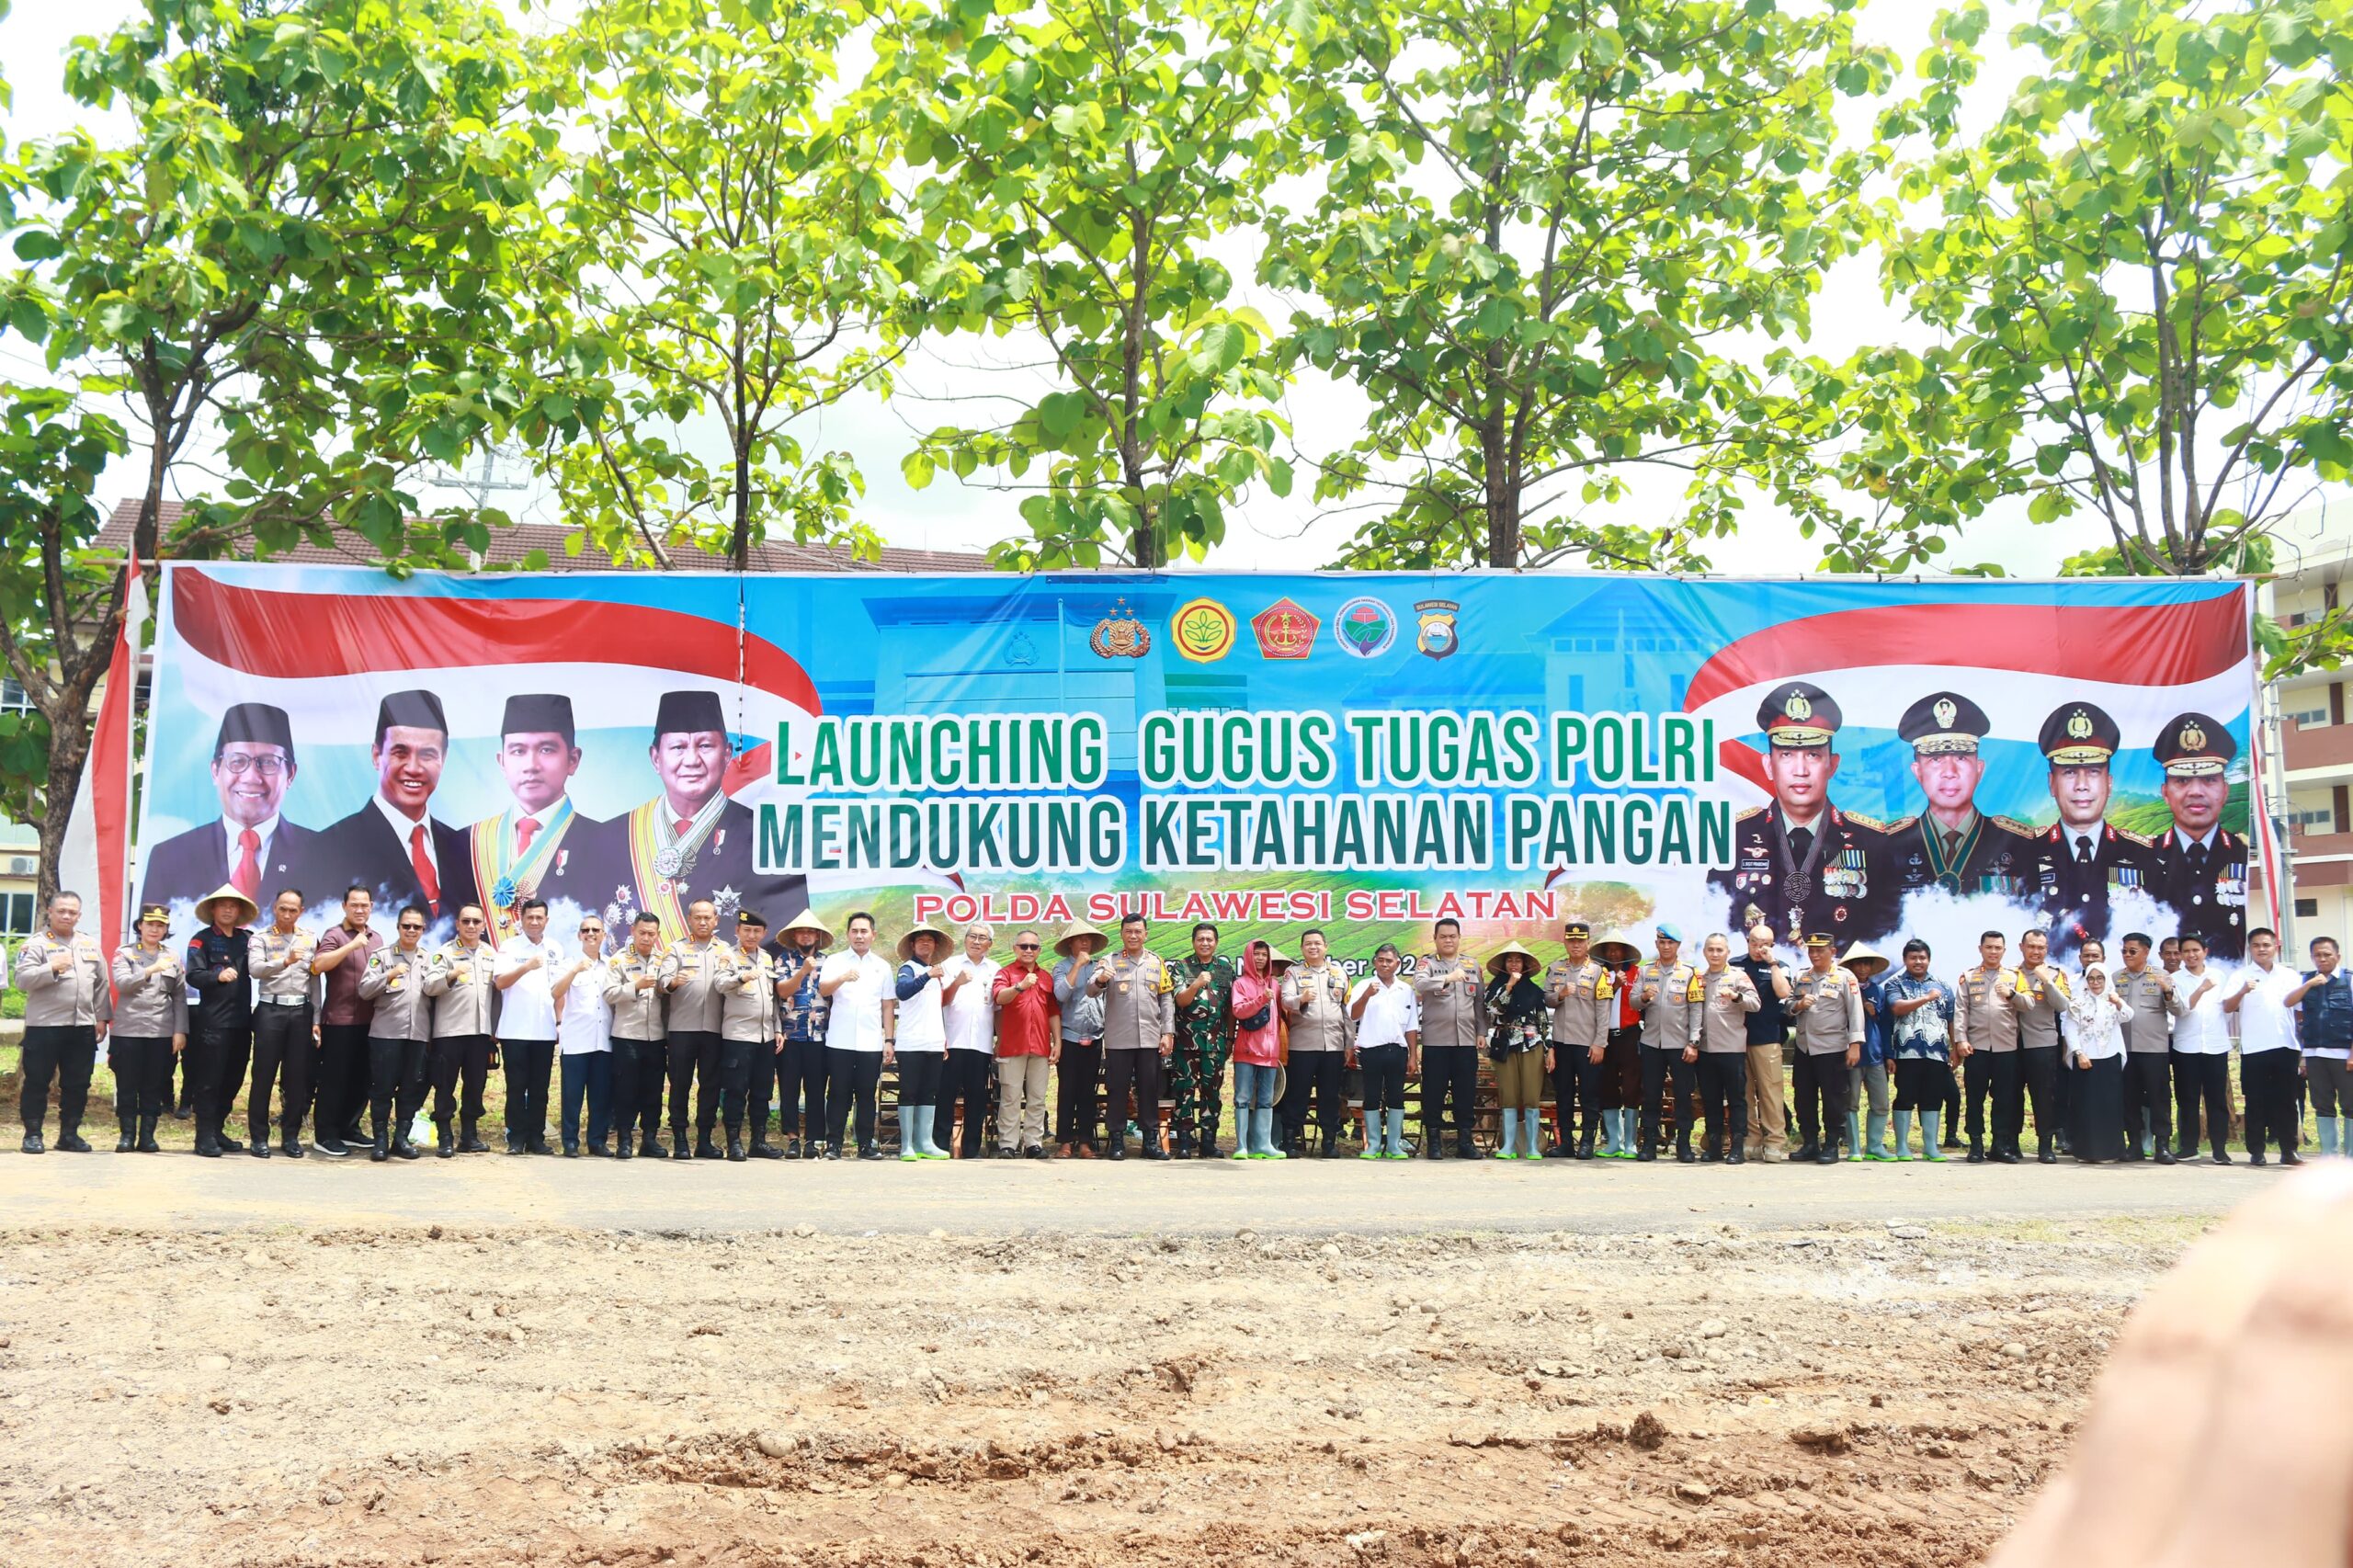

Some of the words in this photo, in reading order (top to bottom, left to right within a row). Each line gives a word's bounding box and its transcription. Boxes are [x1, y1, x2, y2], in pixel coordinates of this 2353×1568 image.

[777, 718, 1102, 787] LAUNCHING
[1144, 716, 1330, 783] GUGUS
[1351, 716, 1534, 782] TUGAS
[1557, 717, 1714, 782] POLRI
[758, 801, 1120, 869] MENDUKUNG
[1146, 800, 1486, 865] KETAHANAN
[1512, 800, 1730, 865] PANGAN
[917, 894, 1073, 922] POLDA
[1089, 893, 1329, 921] SULAWESI
[1347, 892, 1555, 919] SELATAN
